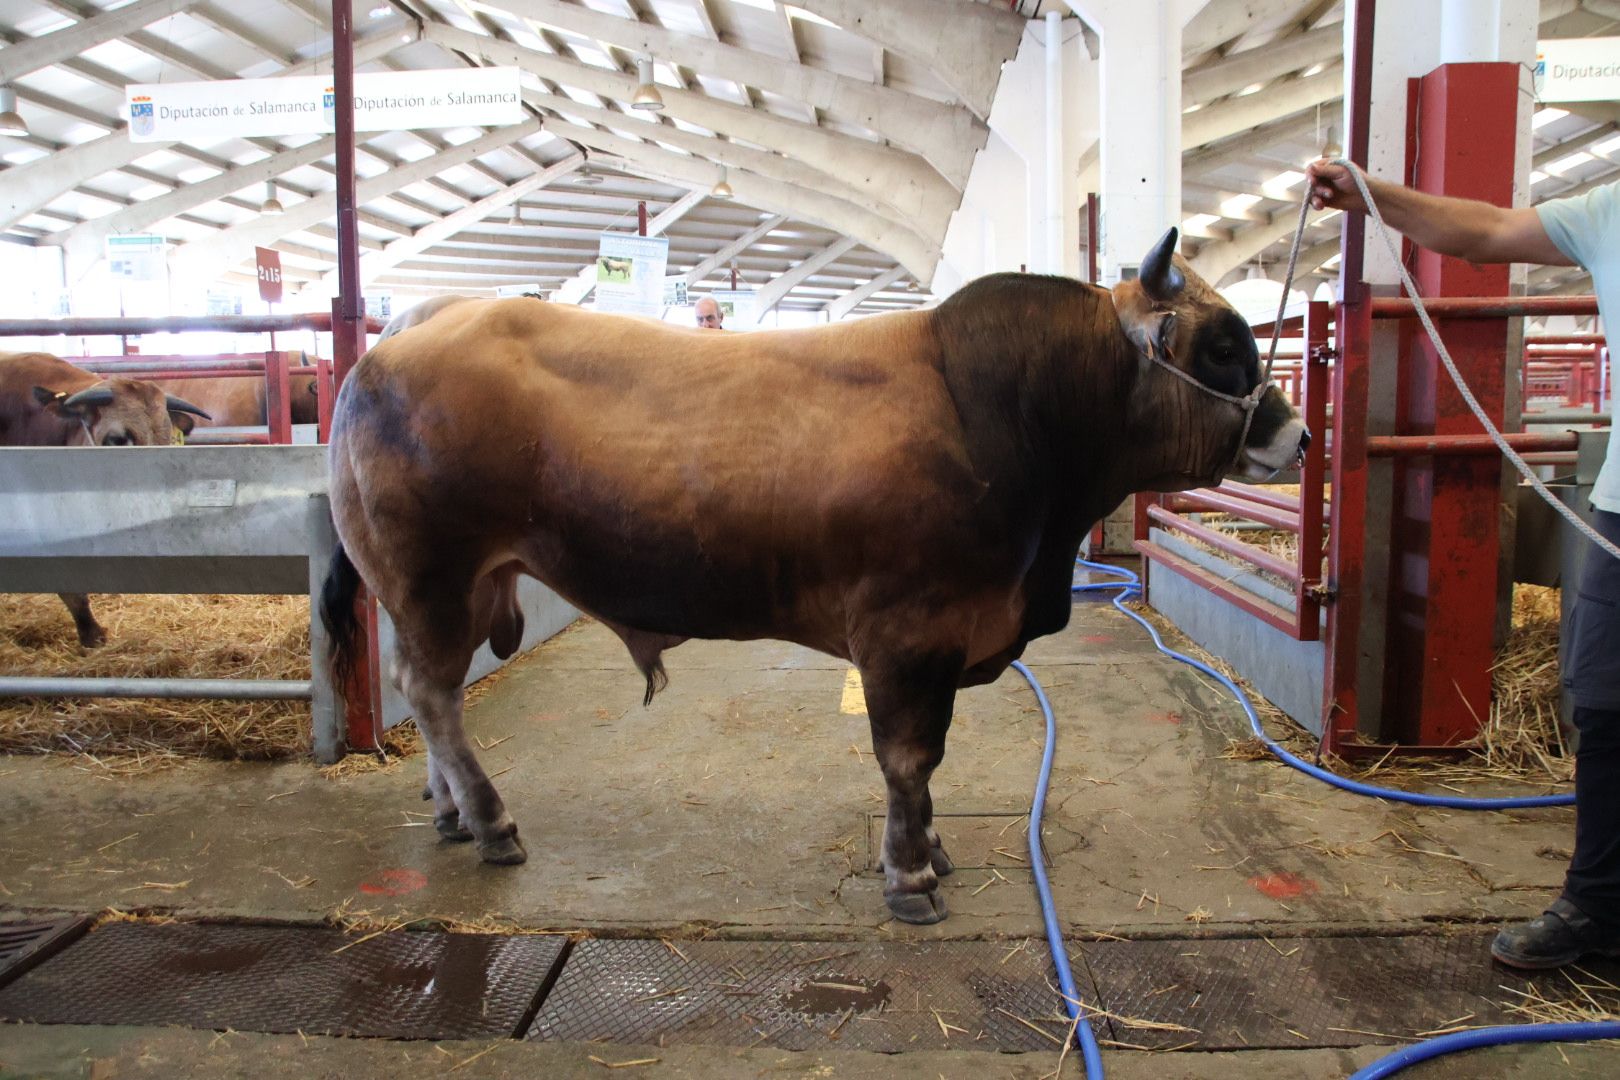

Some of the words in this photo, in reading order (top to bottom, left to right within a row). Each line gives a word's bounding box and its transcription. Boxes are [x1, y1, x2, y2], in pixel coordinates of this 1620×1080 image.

[160, 102, 228, 121] Diputación
[233, 104, 244, 116] de
[249, 101, 316, 116] Salamanca
[354, 94, 425, 112] Diputación
[430, 95, 442, 106] de
[447, 90, 517, 105] Salamanca
